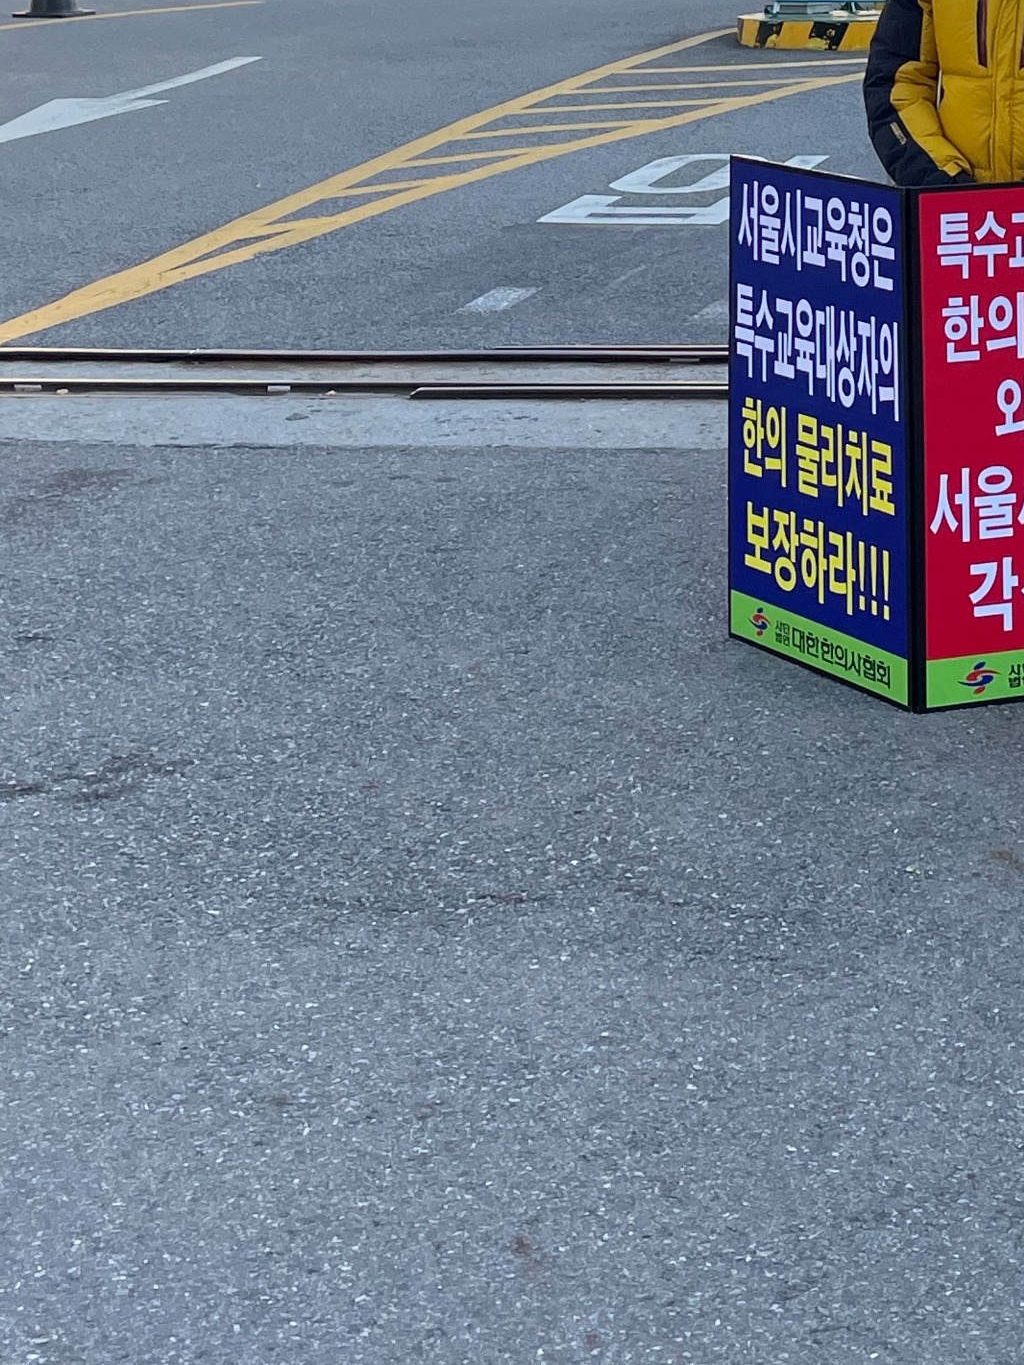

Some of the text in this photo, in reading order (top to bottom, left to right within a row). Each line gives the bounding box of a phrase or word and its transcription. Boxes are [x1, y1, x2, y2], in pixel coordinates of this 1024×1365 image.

[738, 180, 896, 291] 서울시교육청은
[735, 283, 900, 422] 특수교육대상자의
[742, 397, 896, 516] 한의 물리치료
[744, 501, 890, 621] 보장하라!!!
[792, 627, 891, 689] 대한한의사협회
